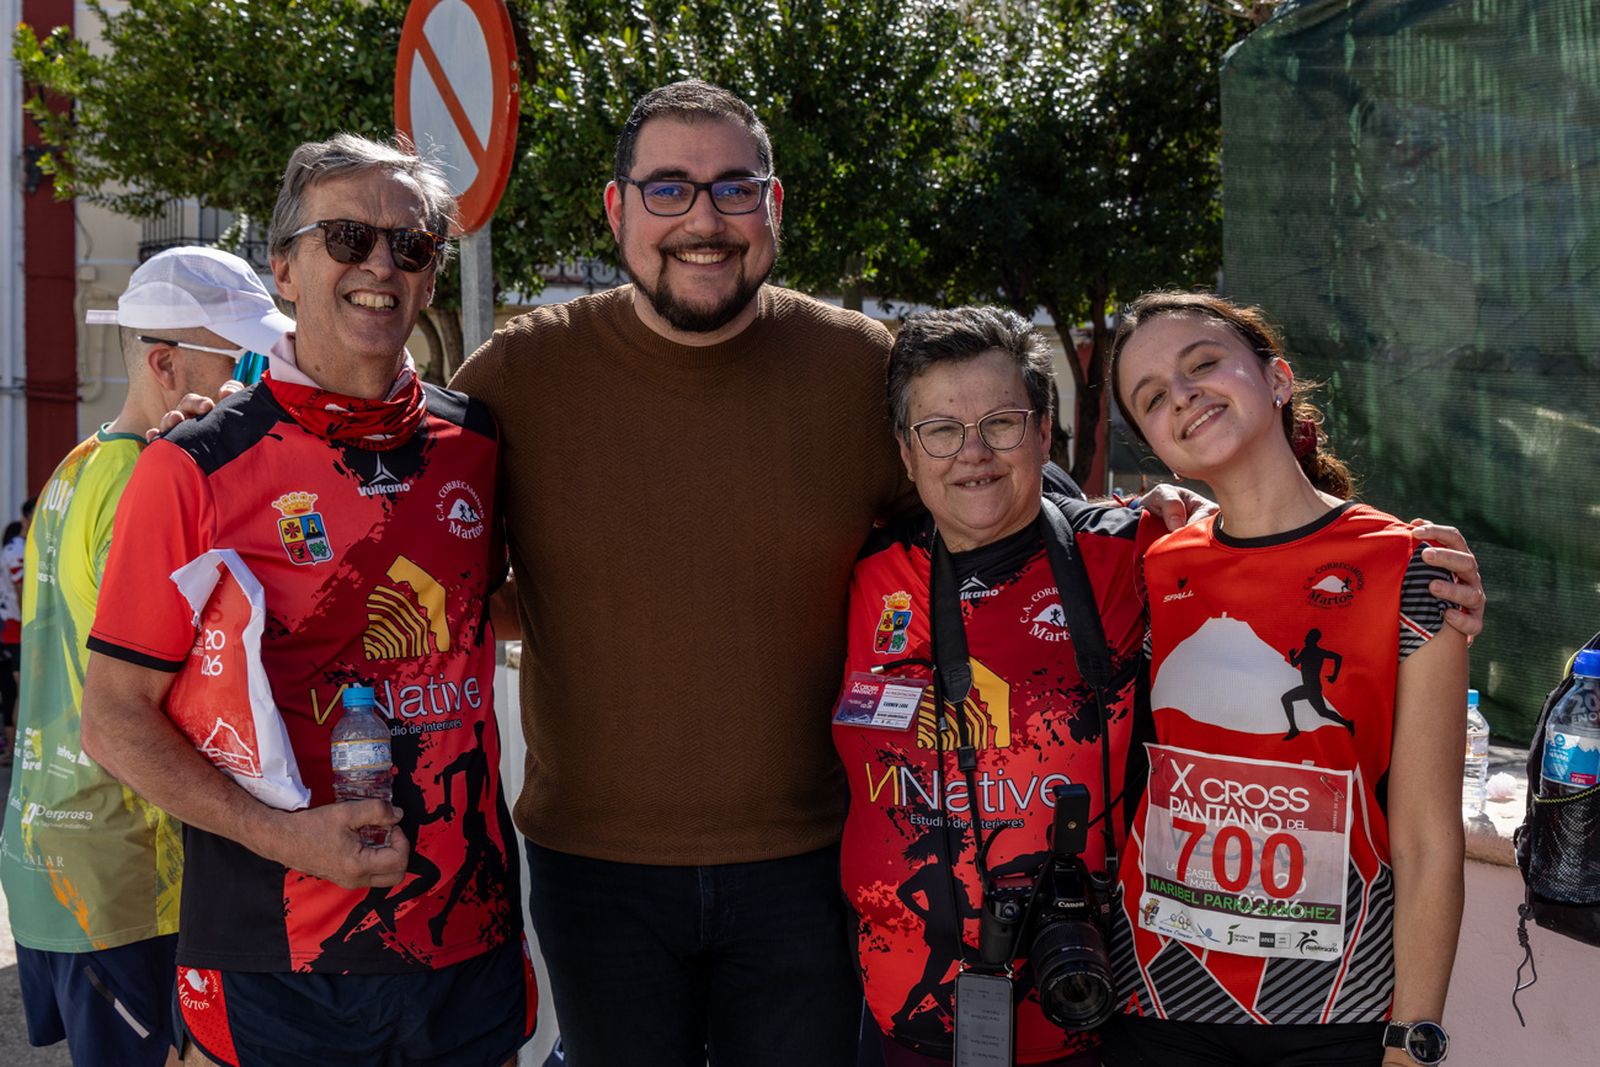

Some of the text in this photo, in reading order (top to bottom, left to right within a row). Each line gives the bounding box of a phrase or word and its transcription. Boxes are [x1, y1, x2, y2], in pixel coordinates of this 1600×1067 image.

[357, 482, 411, 497] Vulkano
[448, 520, 485, 539] Martos
[1311, 590, 1353, 605] Martos
[1028, 622, 1072, 642] Mart
[409, 724, 421, 735] de
[1170, 758, 1310, 813] X CROSS
[36, 804, 94, 821] Derprosa
[1169, 796, 1310, 835] PANTANO DEL
[952, 817, 968, 829] de
[1172, 816, 1305, 900] 700
[1149, 877, 1200, 905] MARIBEL
[1058, 900, 1085, 909] Canon
[178, 983, 210, 1010] Martos
